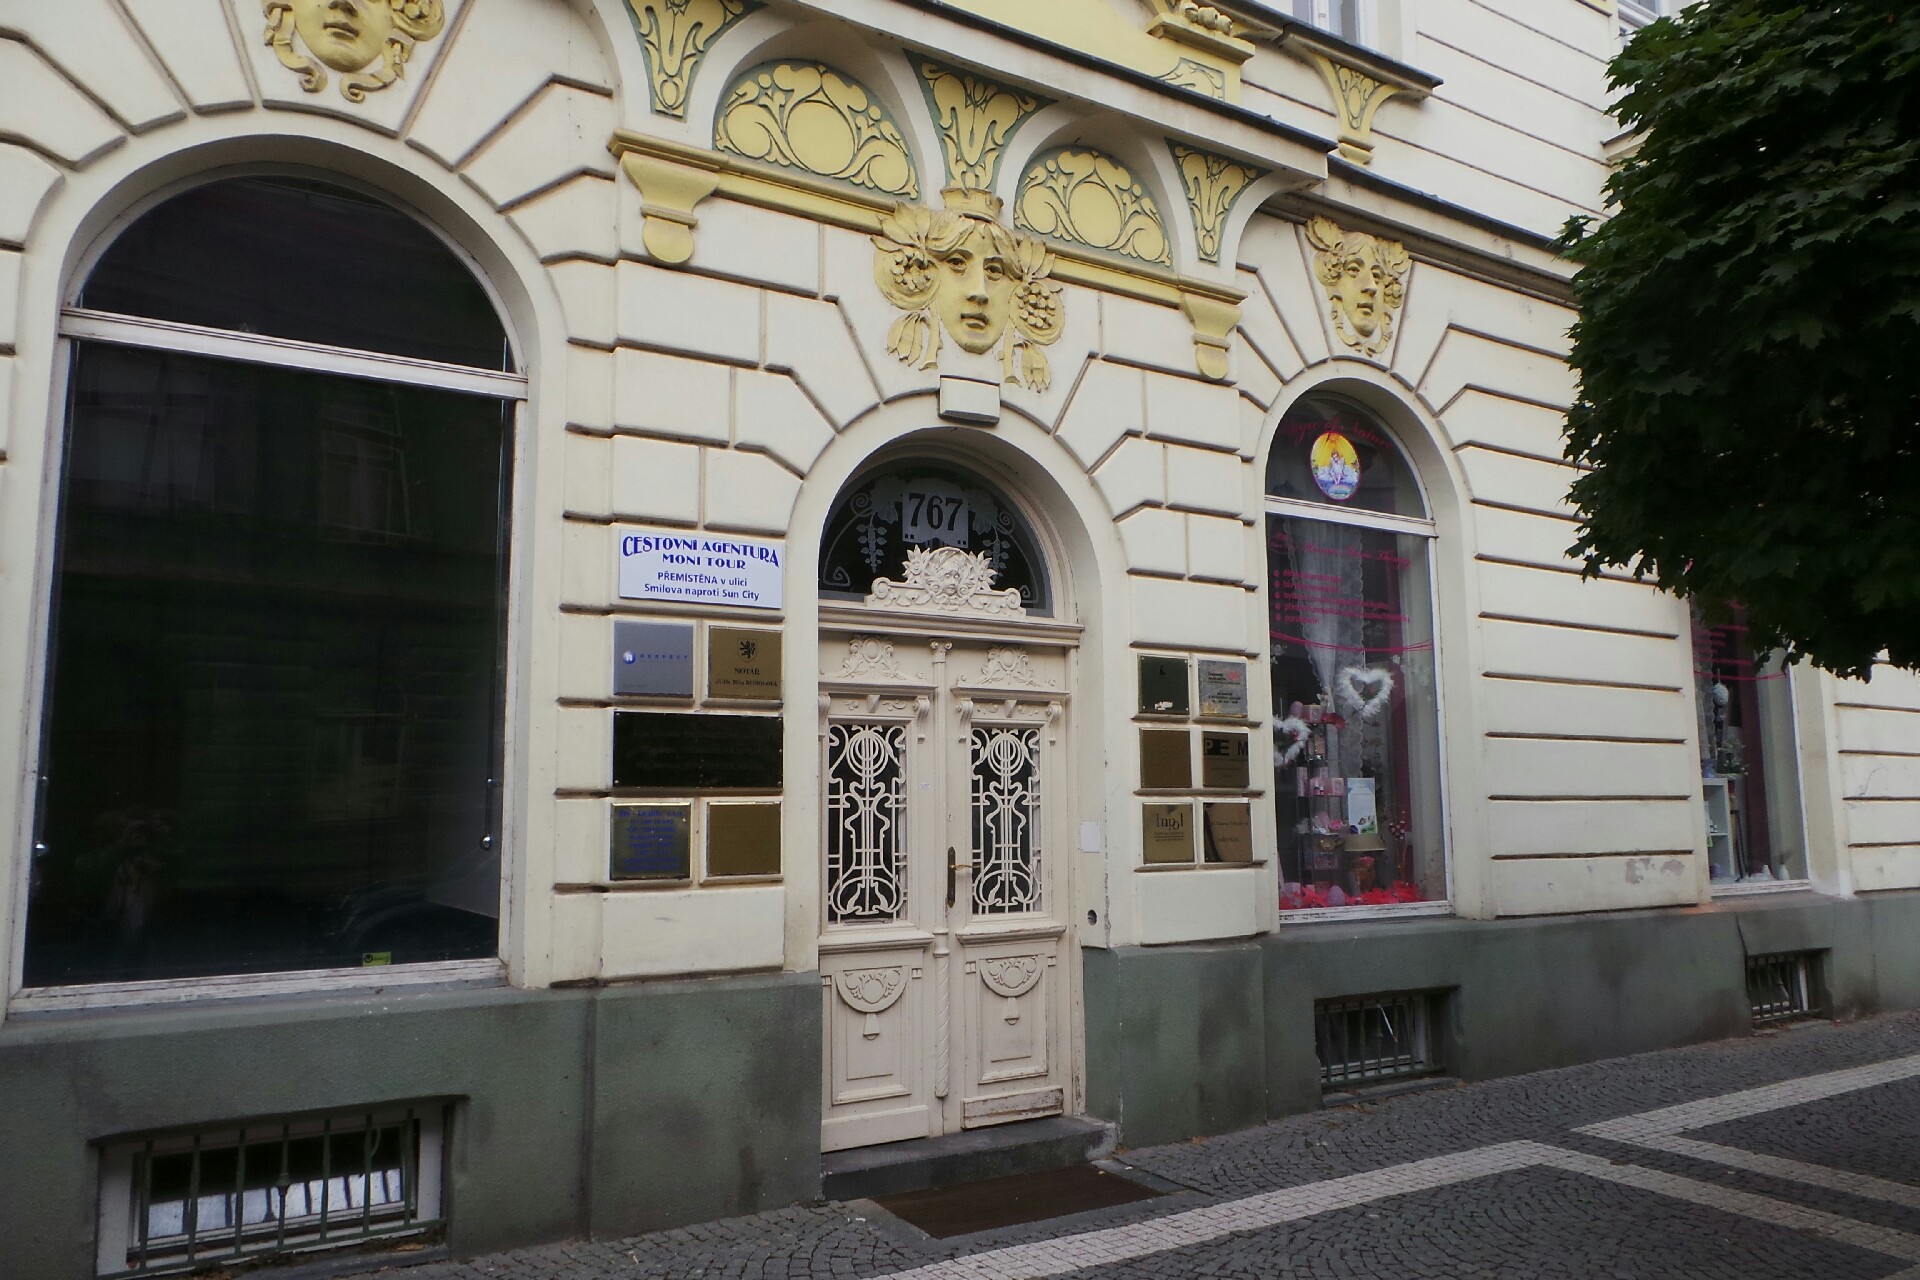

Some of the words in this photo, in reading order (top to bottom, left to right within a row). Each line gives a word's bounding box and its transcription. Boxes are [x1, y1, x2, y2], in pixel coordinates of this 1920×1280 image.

[908, 492, 964, 531] 767
[662, 553, 701, 566] MONI
[705, 556, 746, 570] TOUR
[701, 540, 780, 568] AGENTURA
[657, 571, 718, 584] PŘEMÍSTĚNA
[728, 577, 748, 587] ulici
[644, 583, 682, 595] Smilova
[685, 586, 719, 598] naproti
[722, 589, 739, 599] Sun
[742, 590, 760, 602] City
